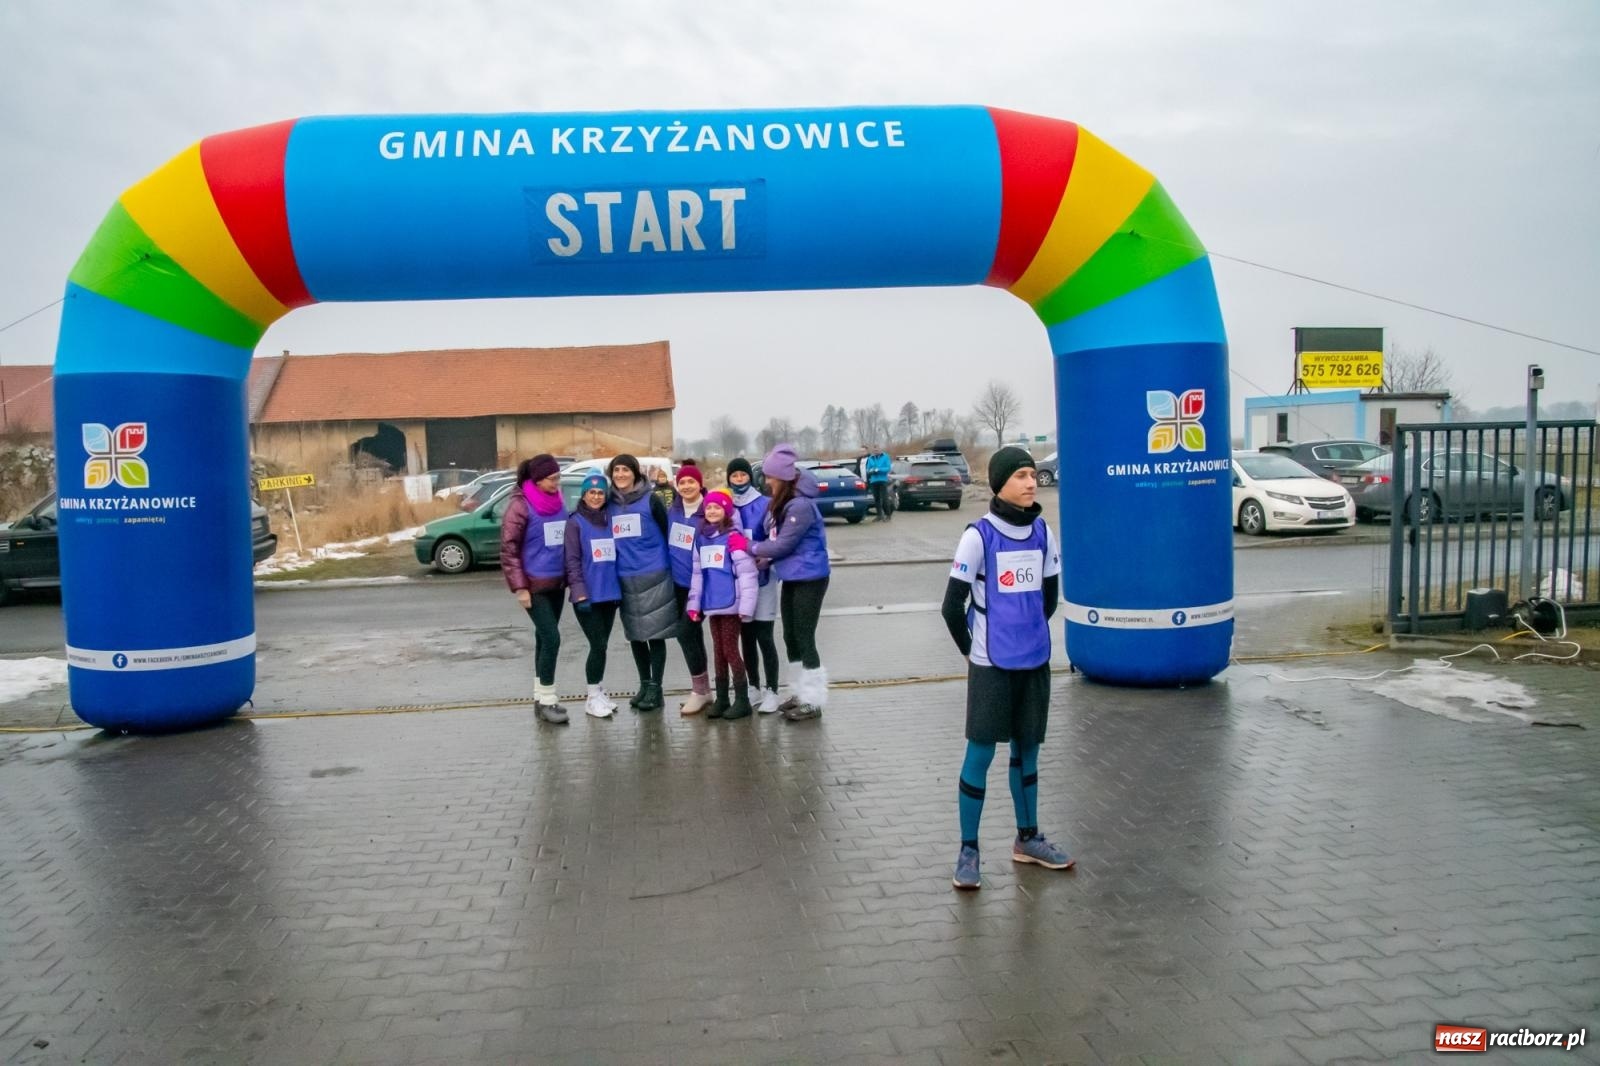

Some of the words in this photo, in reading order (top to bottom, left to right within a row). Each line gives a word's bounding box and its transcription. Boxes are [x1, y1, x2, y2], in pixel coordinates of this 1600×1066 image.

[379, 128, 535, 160] GMINA
[551, 120, 905, 154] KRZYŻANOWICE
[545, 187, 746, 257] START
[1302, 364, 1325, 377] 575
[1329, 364, 1352, 376] 792
[1356, 363, 1380, 376] 626
[1107, 464, 1150, 476] GMINA
[1154, 459, 1229, 475] KRZYŻANOWICE
[260, 477, 303, 489] PARKING
[60, 497, 87, 509] GMINA
[89, 495, 196, 510] KRZYŻANOWICE
[620, 523, 631, 533] 64
[1016, 568, 1034, 583] 66
